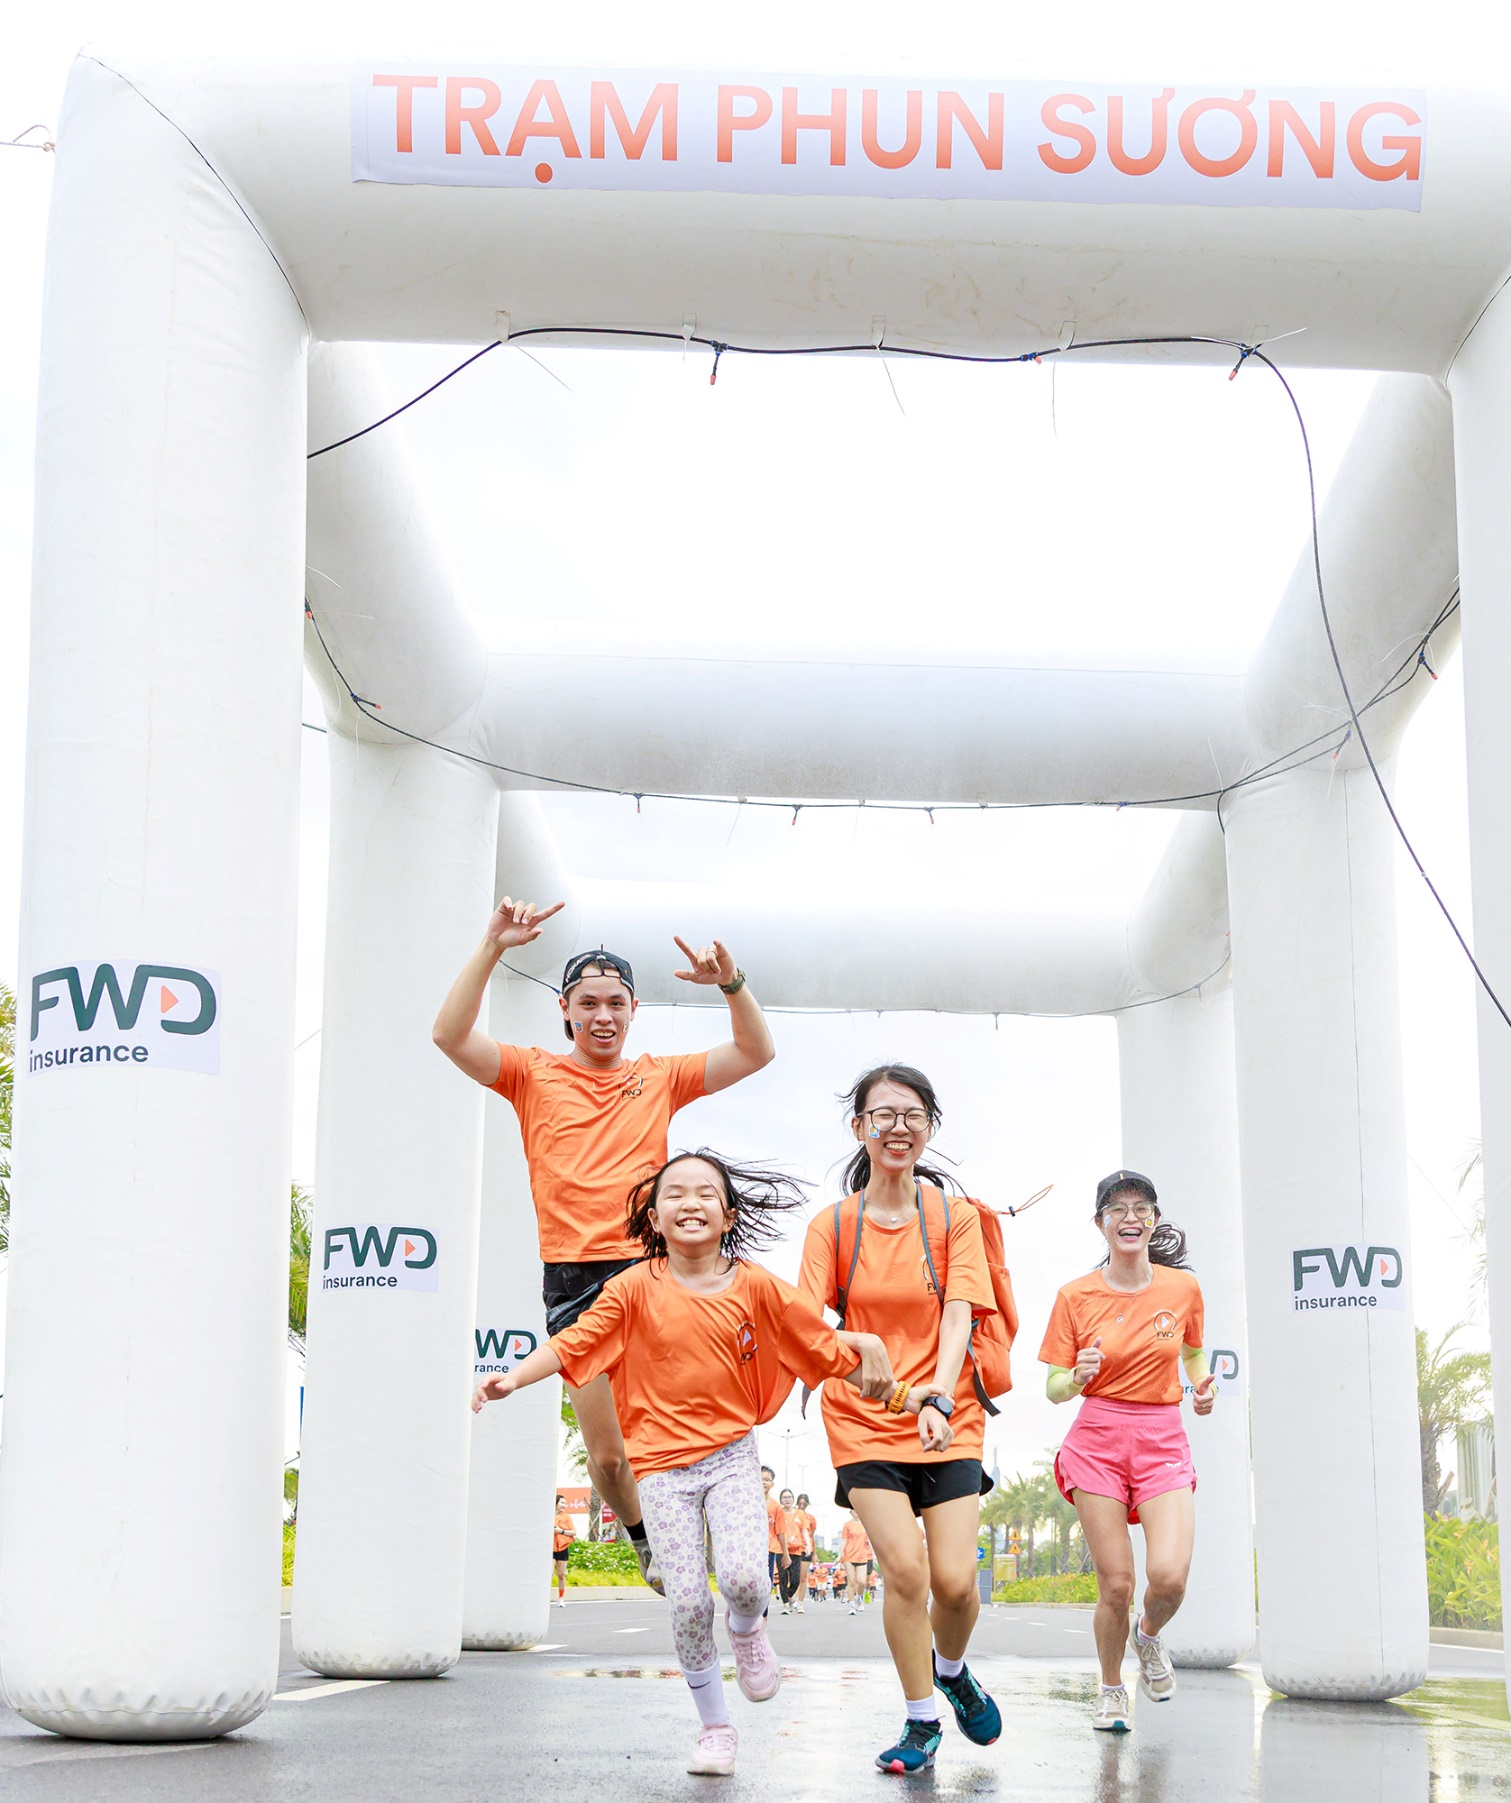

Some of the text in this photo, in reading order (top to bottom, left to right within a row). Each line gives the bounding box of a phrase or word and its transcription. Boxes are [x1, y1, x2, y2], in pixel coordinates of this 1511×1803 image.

[372, 74, 1422, 184] TRẠM PHUN SƯƠNG
[29, 963, 217, 1042] FWD
[29, 1045, 149, 1073] insurance
[323, 1225, 438, 1271] FWD
[322, 1275, 398, 1290] insurance
[1292, 1246, 1403, 1292] FWD
[1294, 1295, 1378, 1311] insurance
[475, 1328, 538, 1360] WD
[474, 1364, 510, 1374] rance
